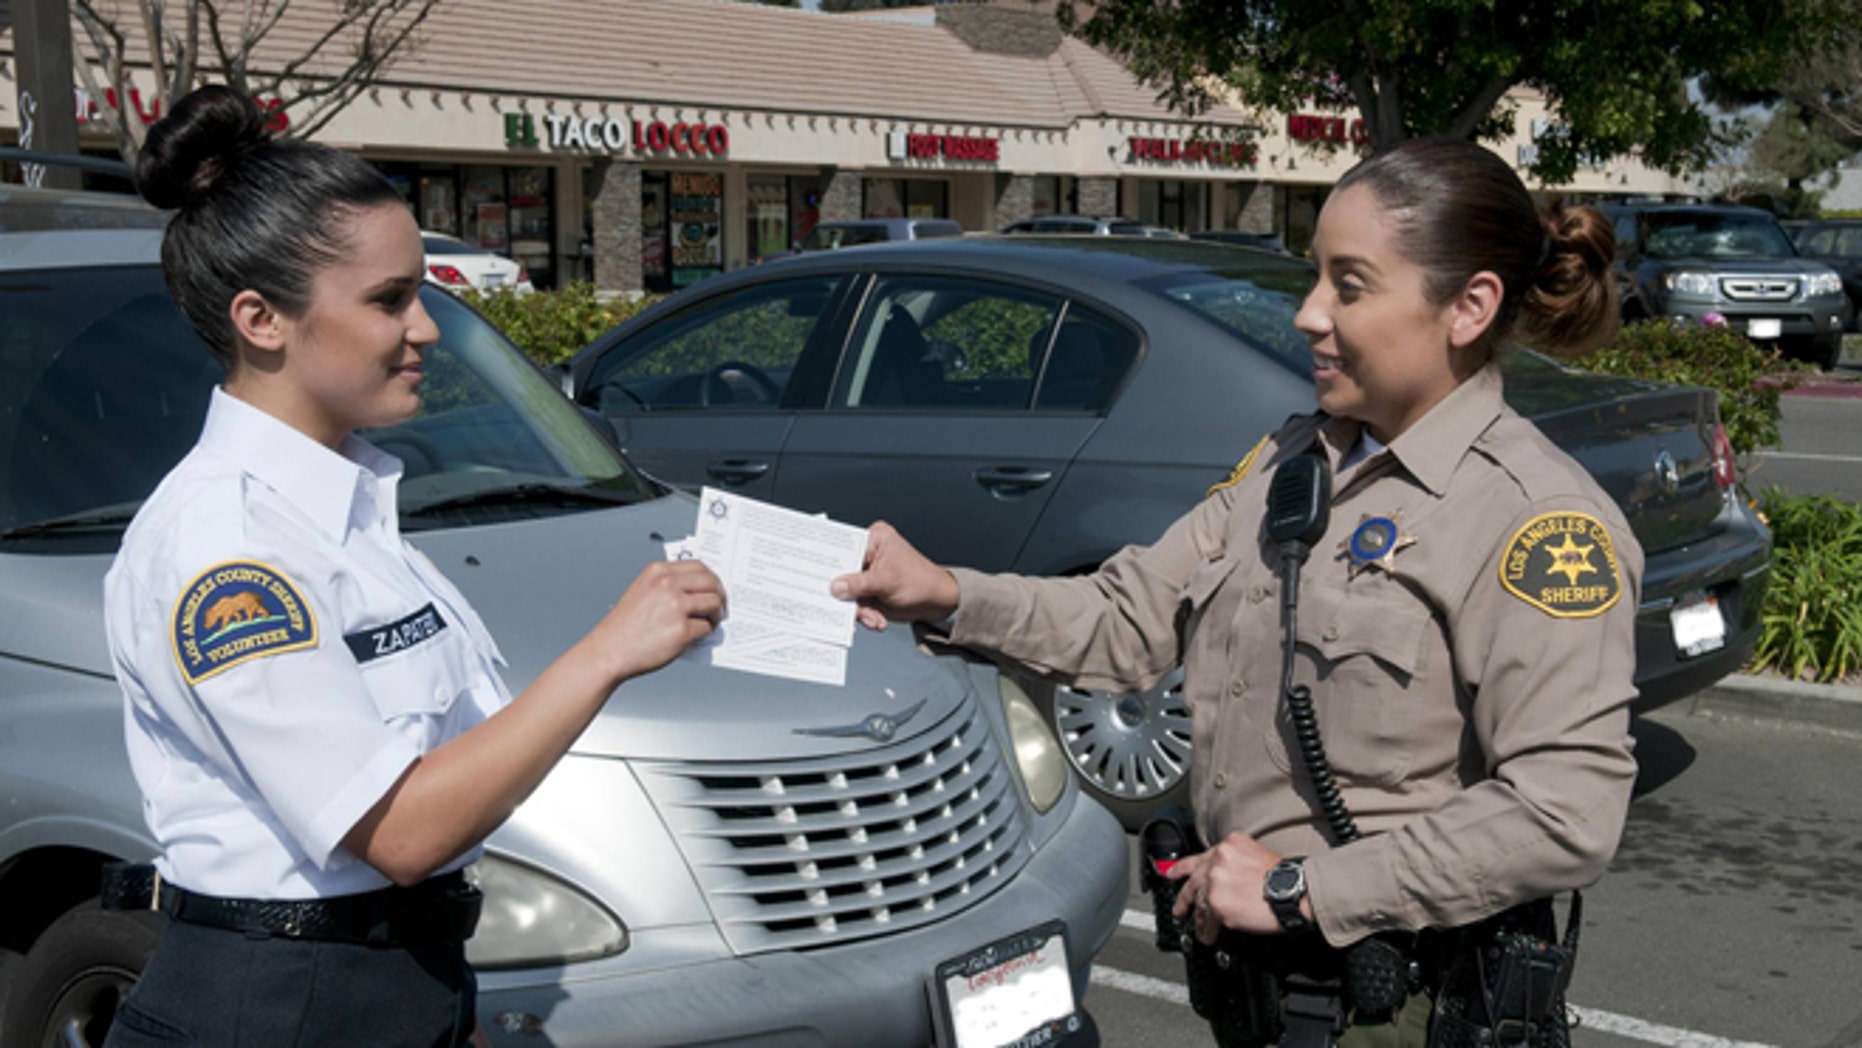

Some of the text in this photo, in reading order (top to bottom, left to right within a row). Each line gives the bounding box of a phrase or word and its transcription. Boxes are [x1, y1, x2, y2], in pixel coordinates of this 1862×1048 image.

[504, 112, 730, 154] EL TACO LOCCO
[1508, 549, 1530, 580] LOS
[1519, 519, 1588, 551] ANGELES
[214, 567, 272, 587] COUNTY
[1540, 586, 1608, 604] SHERIFF
[181, 577, 216, 636] ANGELES
[181, 637, 203, 667] LOS
[206, 628, 291, 664] VOLUNTEER
